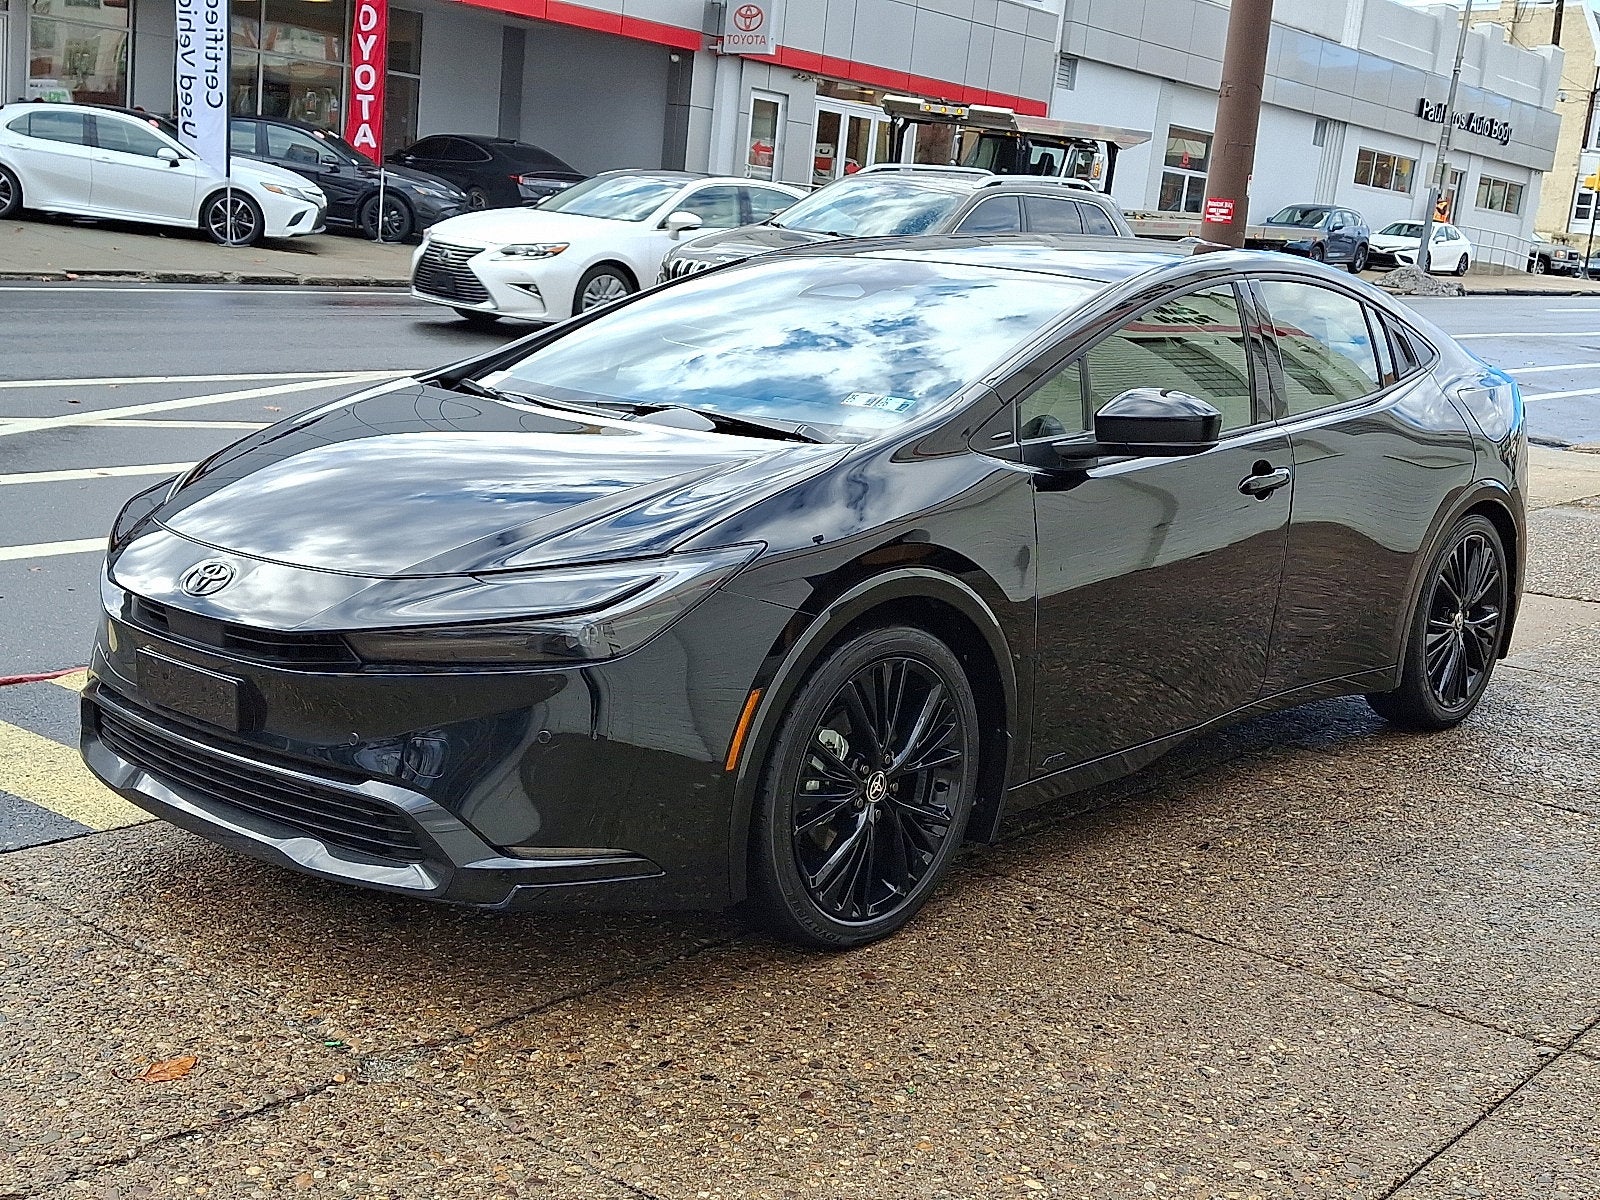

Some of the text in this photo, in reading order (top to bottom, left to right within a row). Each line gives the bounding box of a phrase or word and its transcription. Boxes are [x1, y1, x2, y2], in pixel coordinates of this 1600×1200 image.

[726, 34, 767, 45] TOYOTA
[354, 0, 377, 148] OYOTA
[1419, 98, 1513, 146] Paul ros. Auto Body
